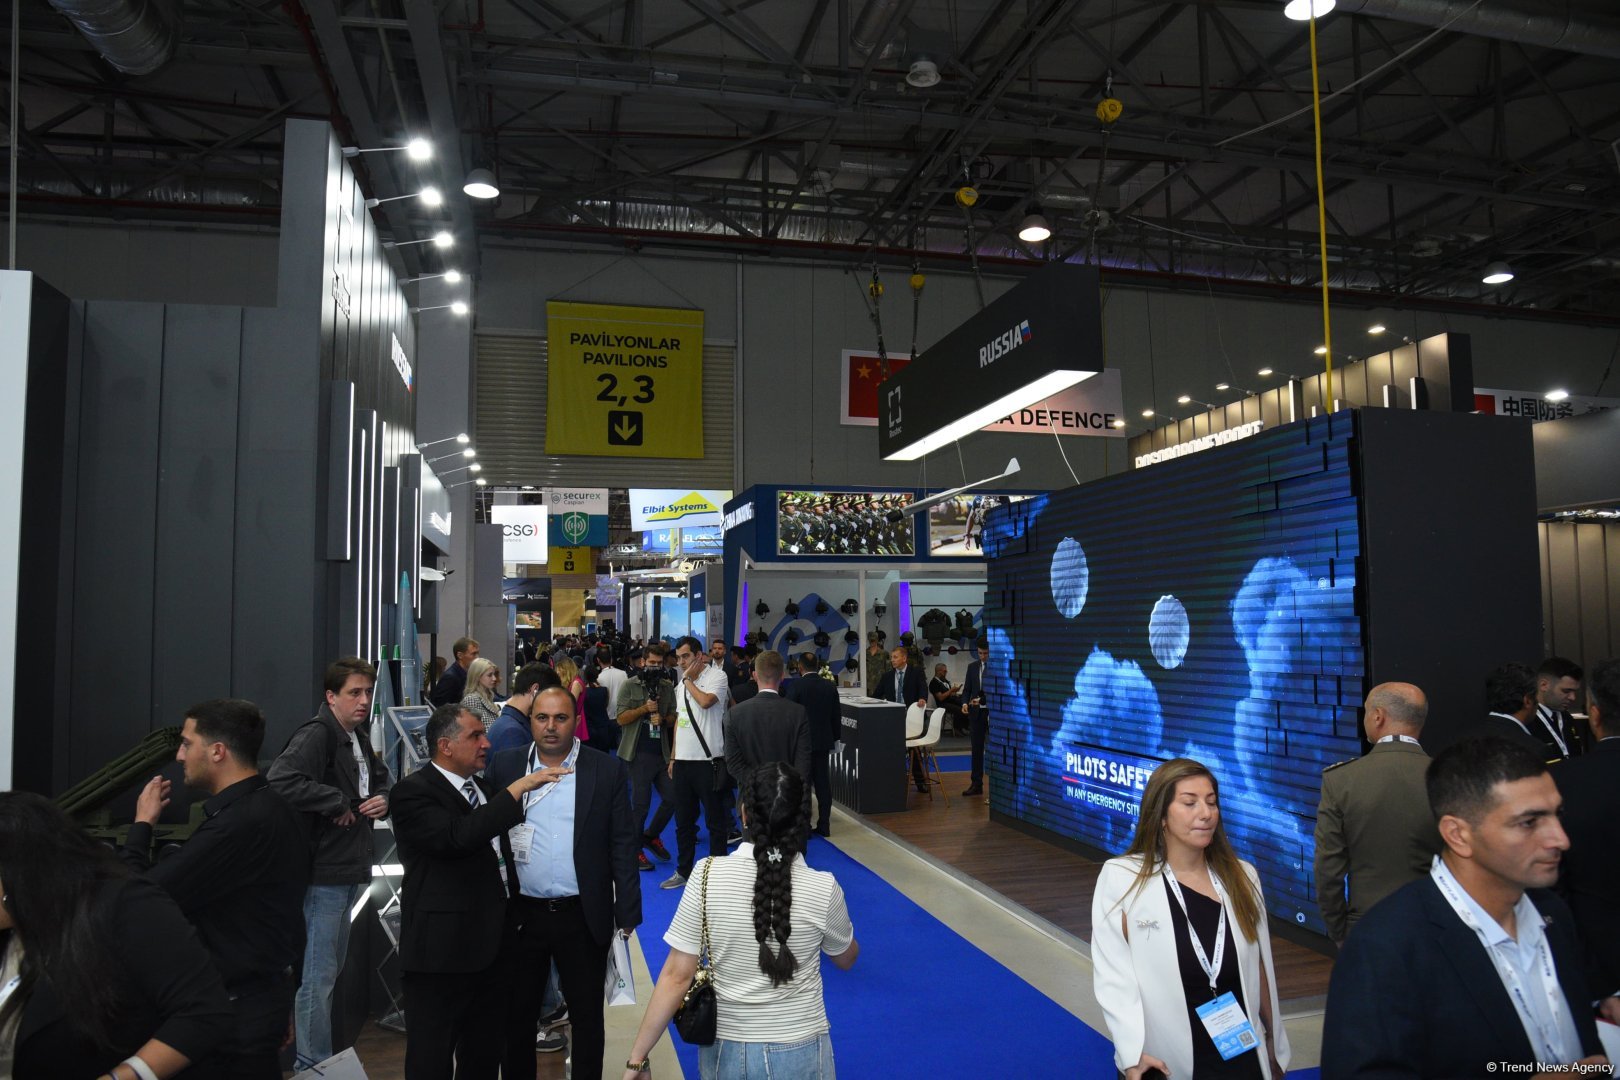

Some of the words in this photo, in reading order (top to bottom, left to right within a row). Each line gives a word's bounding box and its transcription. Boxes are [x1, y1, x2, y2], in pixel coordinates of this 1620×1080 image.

[570, 331, 681, 350] PAVİLYONLAR
[980, 324, 1023, 368] RUSSIA
[583, 352, 668, 368] PAVILIONS
[596, 373, 655, 407] 2,3
[1020, 409, 1118, 430] DEFENCE
[563, 492, 601, 500] securex
[642, 504, 665, 514] Elbit
[668, 503, 708, 512] Systems
[566, 551, 573, 560] 3
[1066, 752, 1107, 780] PILOTS
[1109, 761, 1153, 790] SAFET
[1066, 785, 1074, 797] IN
[1074, 788, 1086, 801] ANY
[1087, 791, 1126, 812] EMERGENCY
